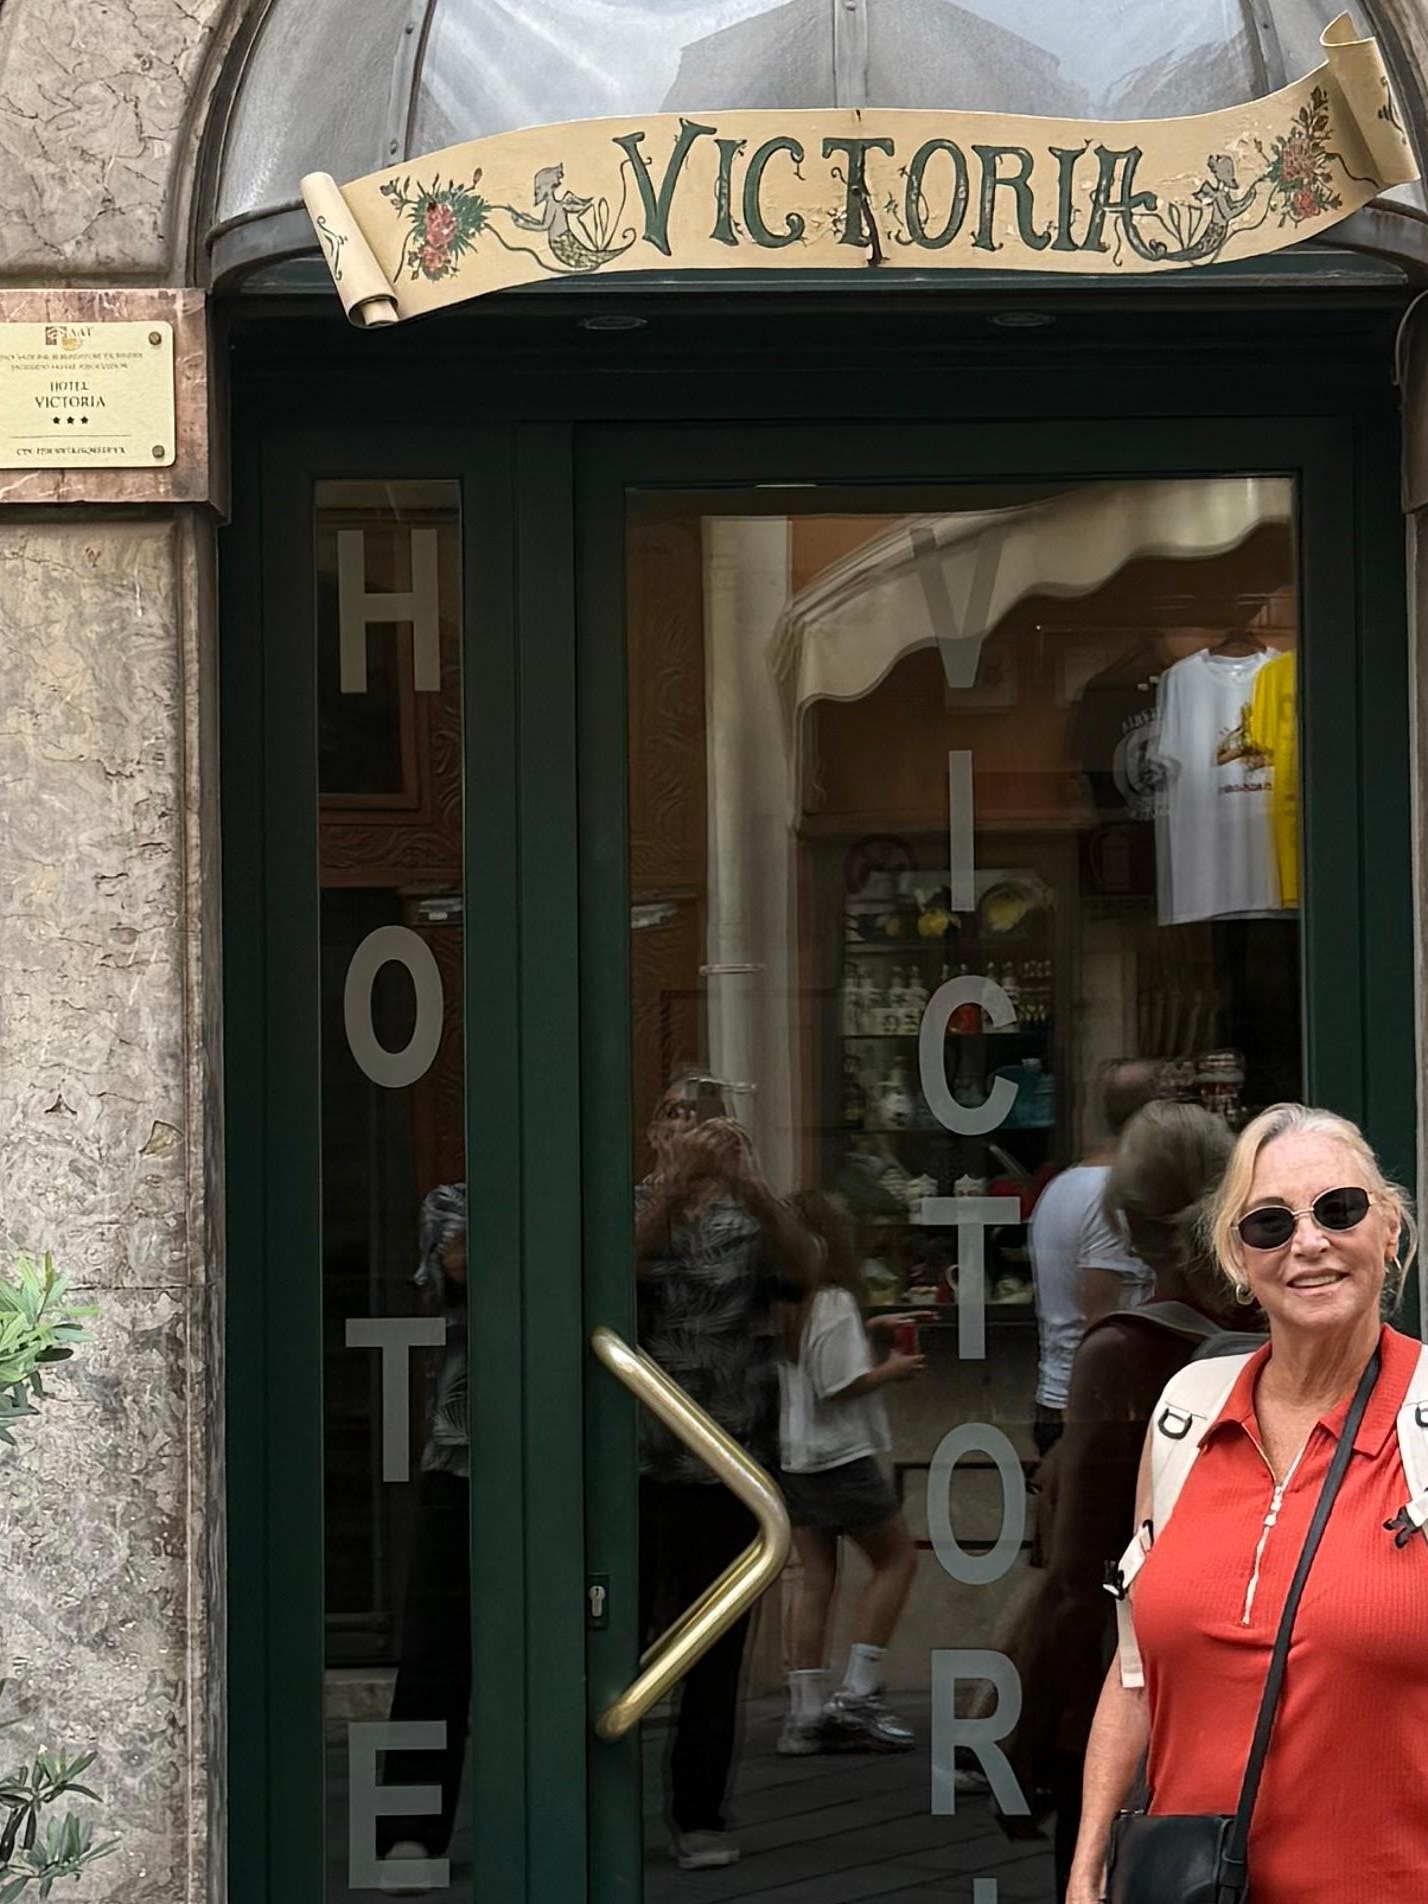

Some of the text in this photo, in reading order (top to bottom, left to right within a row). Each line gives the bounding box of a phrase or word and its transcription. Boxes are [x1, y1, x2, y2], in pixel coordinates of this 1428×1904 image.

[613, 117, 1166, 266] VICTORIA
[50, 381, 89, 391] HOTEL
[34, 395, 106, 408] VICTORIA
